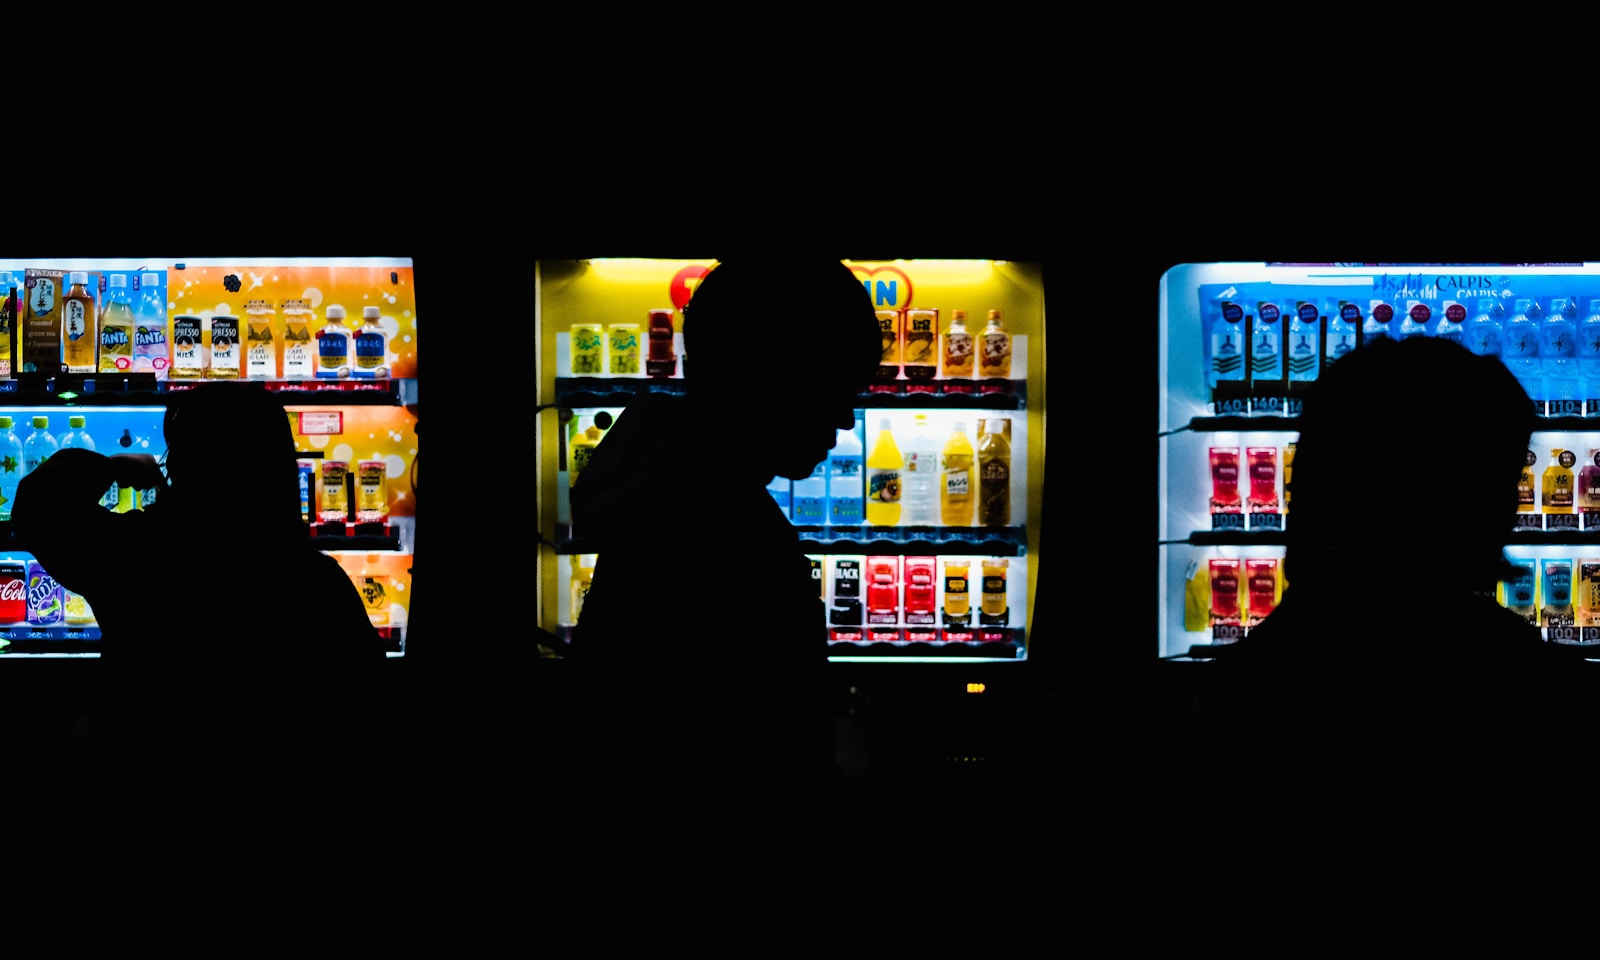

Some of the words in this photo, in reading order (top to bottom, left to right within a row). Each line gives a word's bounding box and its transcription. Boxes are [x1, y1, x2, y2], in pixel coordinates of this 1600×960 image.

[1436, 275, 1492, 292] CALPIS
[101, 332, 128, 345] FANTA
[135, 331, 165, 345] FANTA
[835, 568, 859, 579] BLACK
